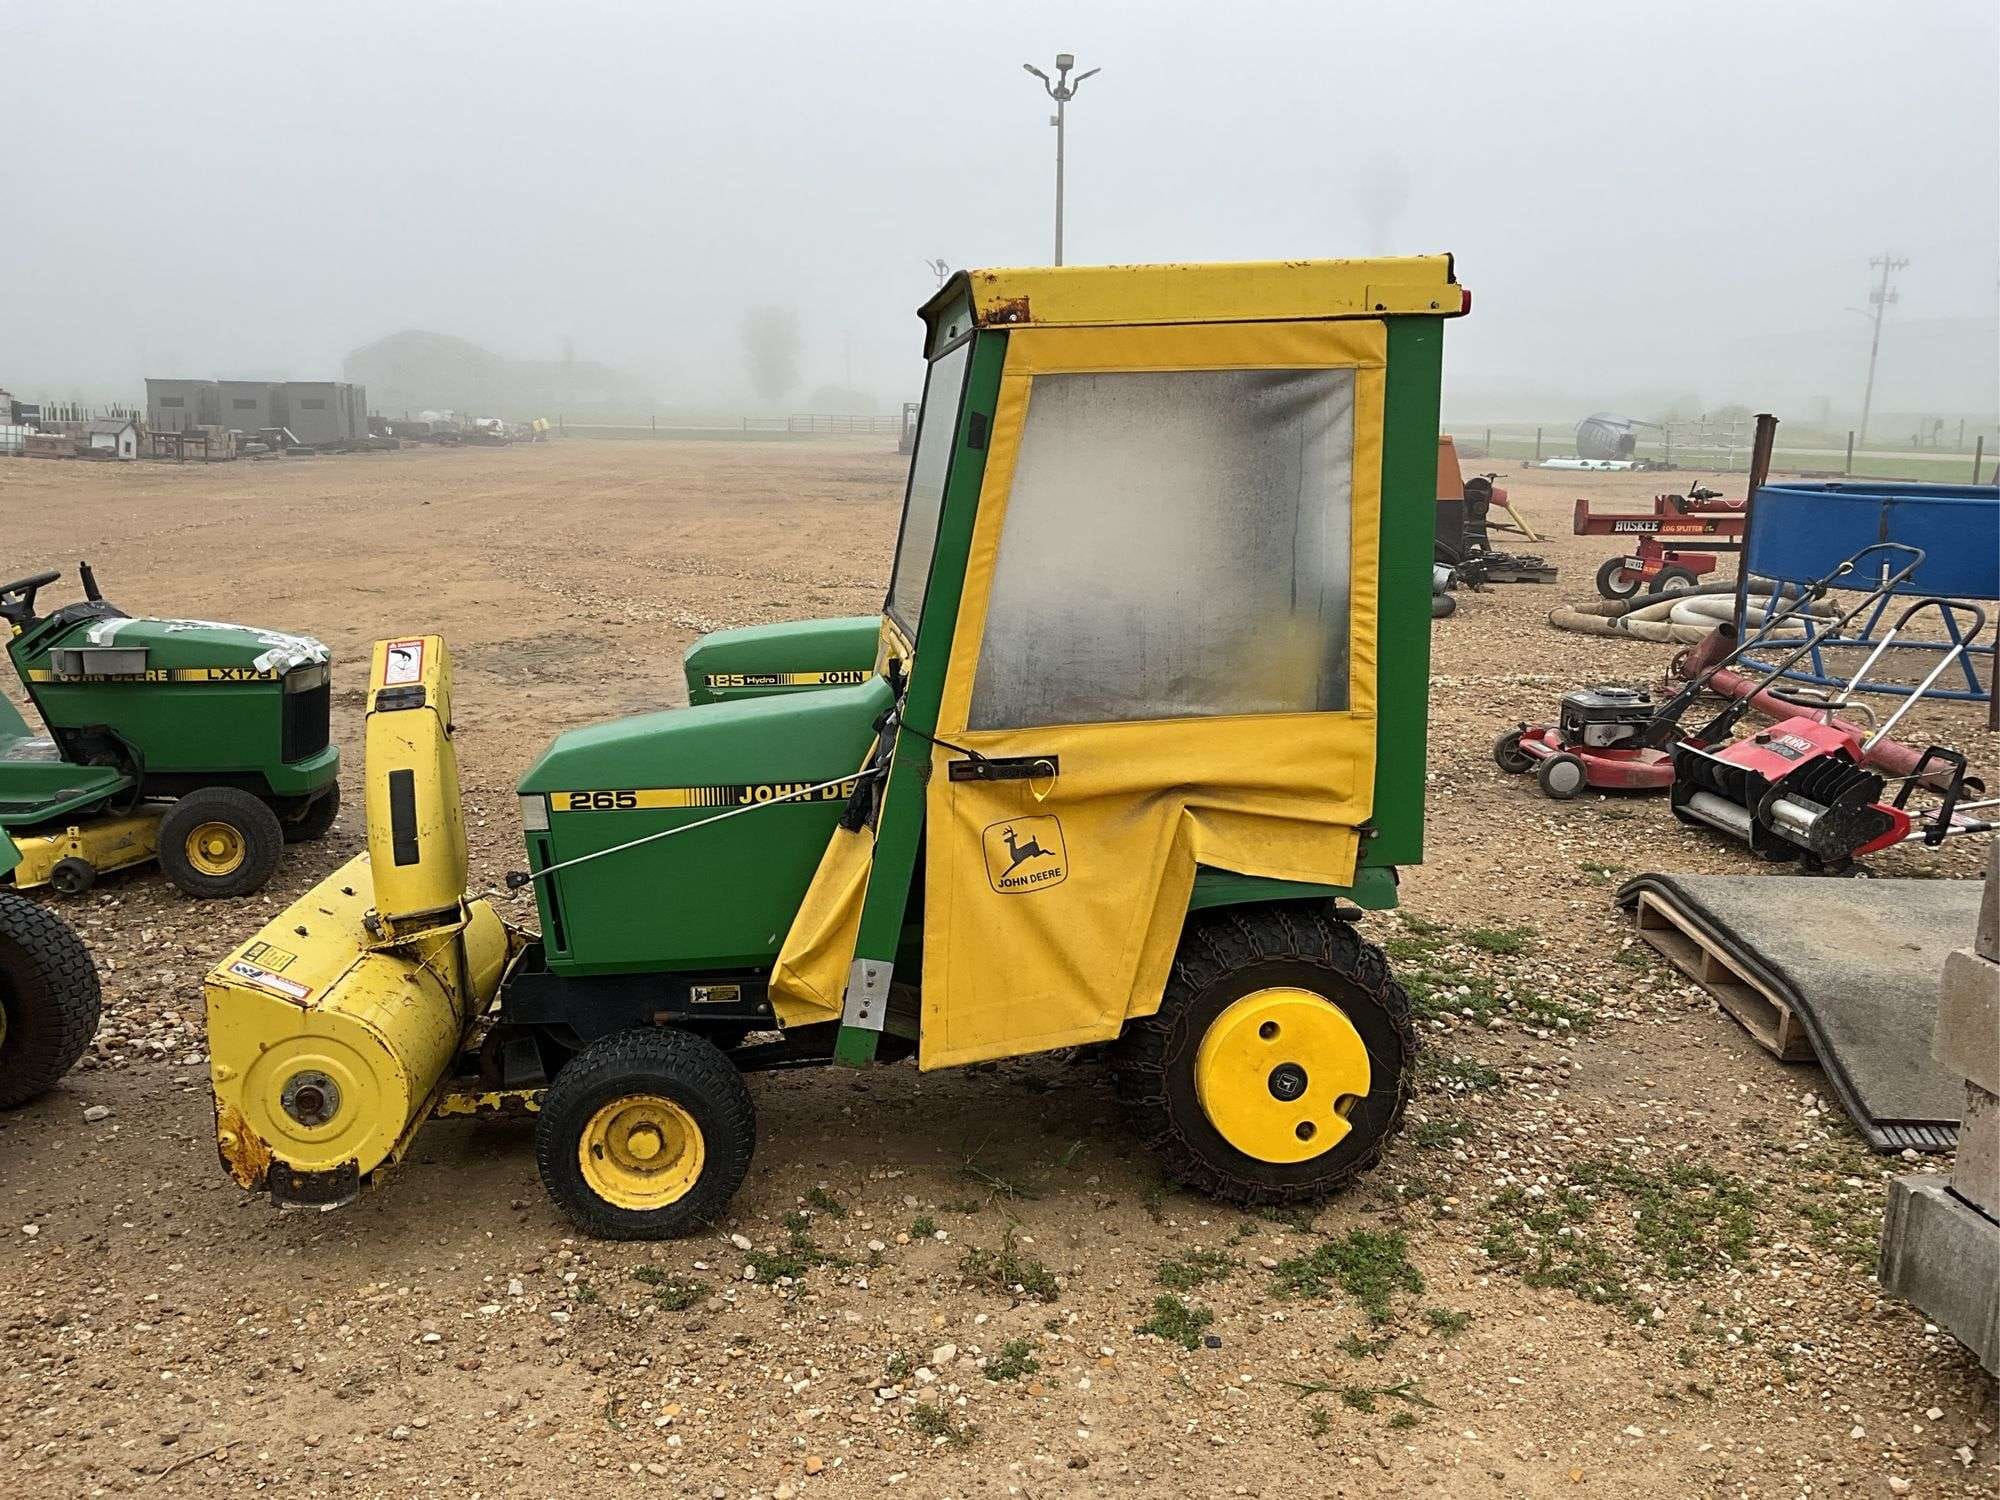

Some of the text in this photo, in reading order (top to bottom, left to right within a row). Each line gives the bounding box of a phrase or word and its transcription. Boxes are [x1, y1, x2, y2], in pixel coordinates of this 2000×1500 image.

[1614, 520, 1659, 532] HUSKEE
[707, 671, 863, 687] 185 Hydro JOHN
[1781, 735, 1811, 751] TORO
[569, 790, 638, 810] 265
[739, 783, 811, 804] JOHN
[998, 868, 1061, 888] JOHN DEERE
